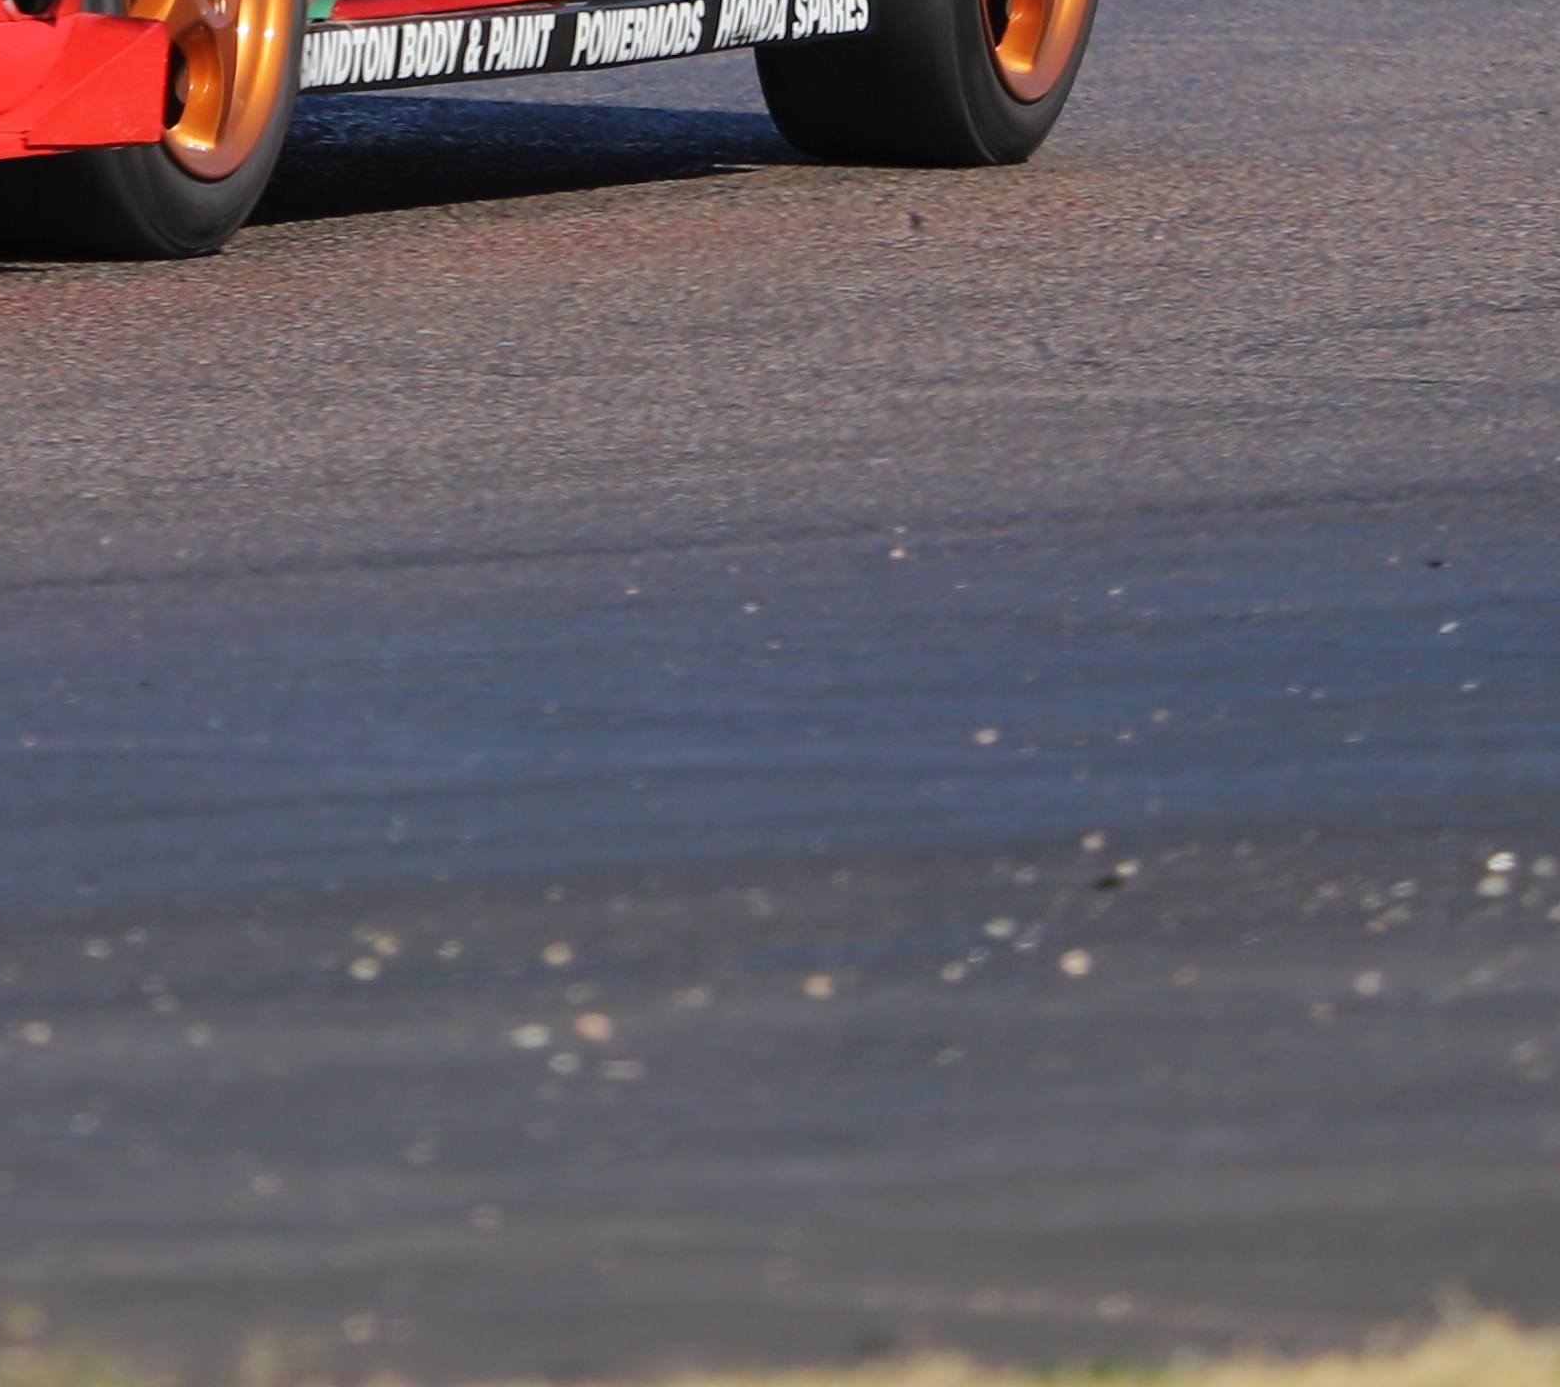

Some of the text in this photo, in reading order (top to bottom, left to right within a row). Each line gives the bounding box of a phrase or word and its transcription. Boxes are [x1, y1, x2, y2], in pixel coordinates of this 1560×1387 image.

[396, 19, 466, 79] BODY
[462, 18, 484, 73] &
[483, 13, 557, 72] PAINT
